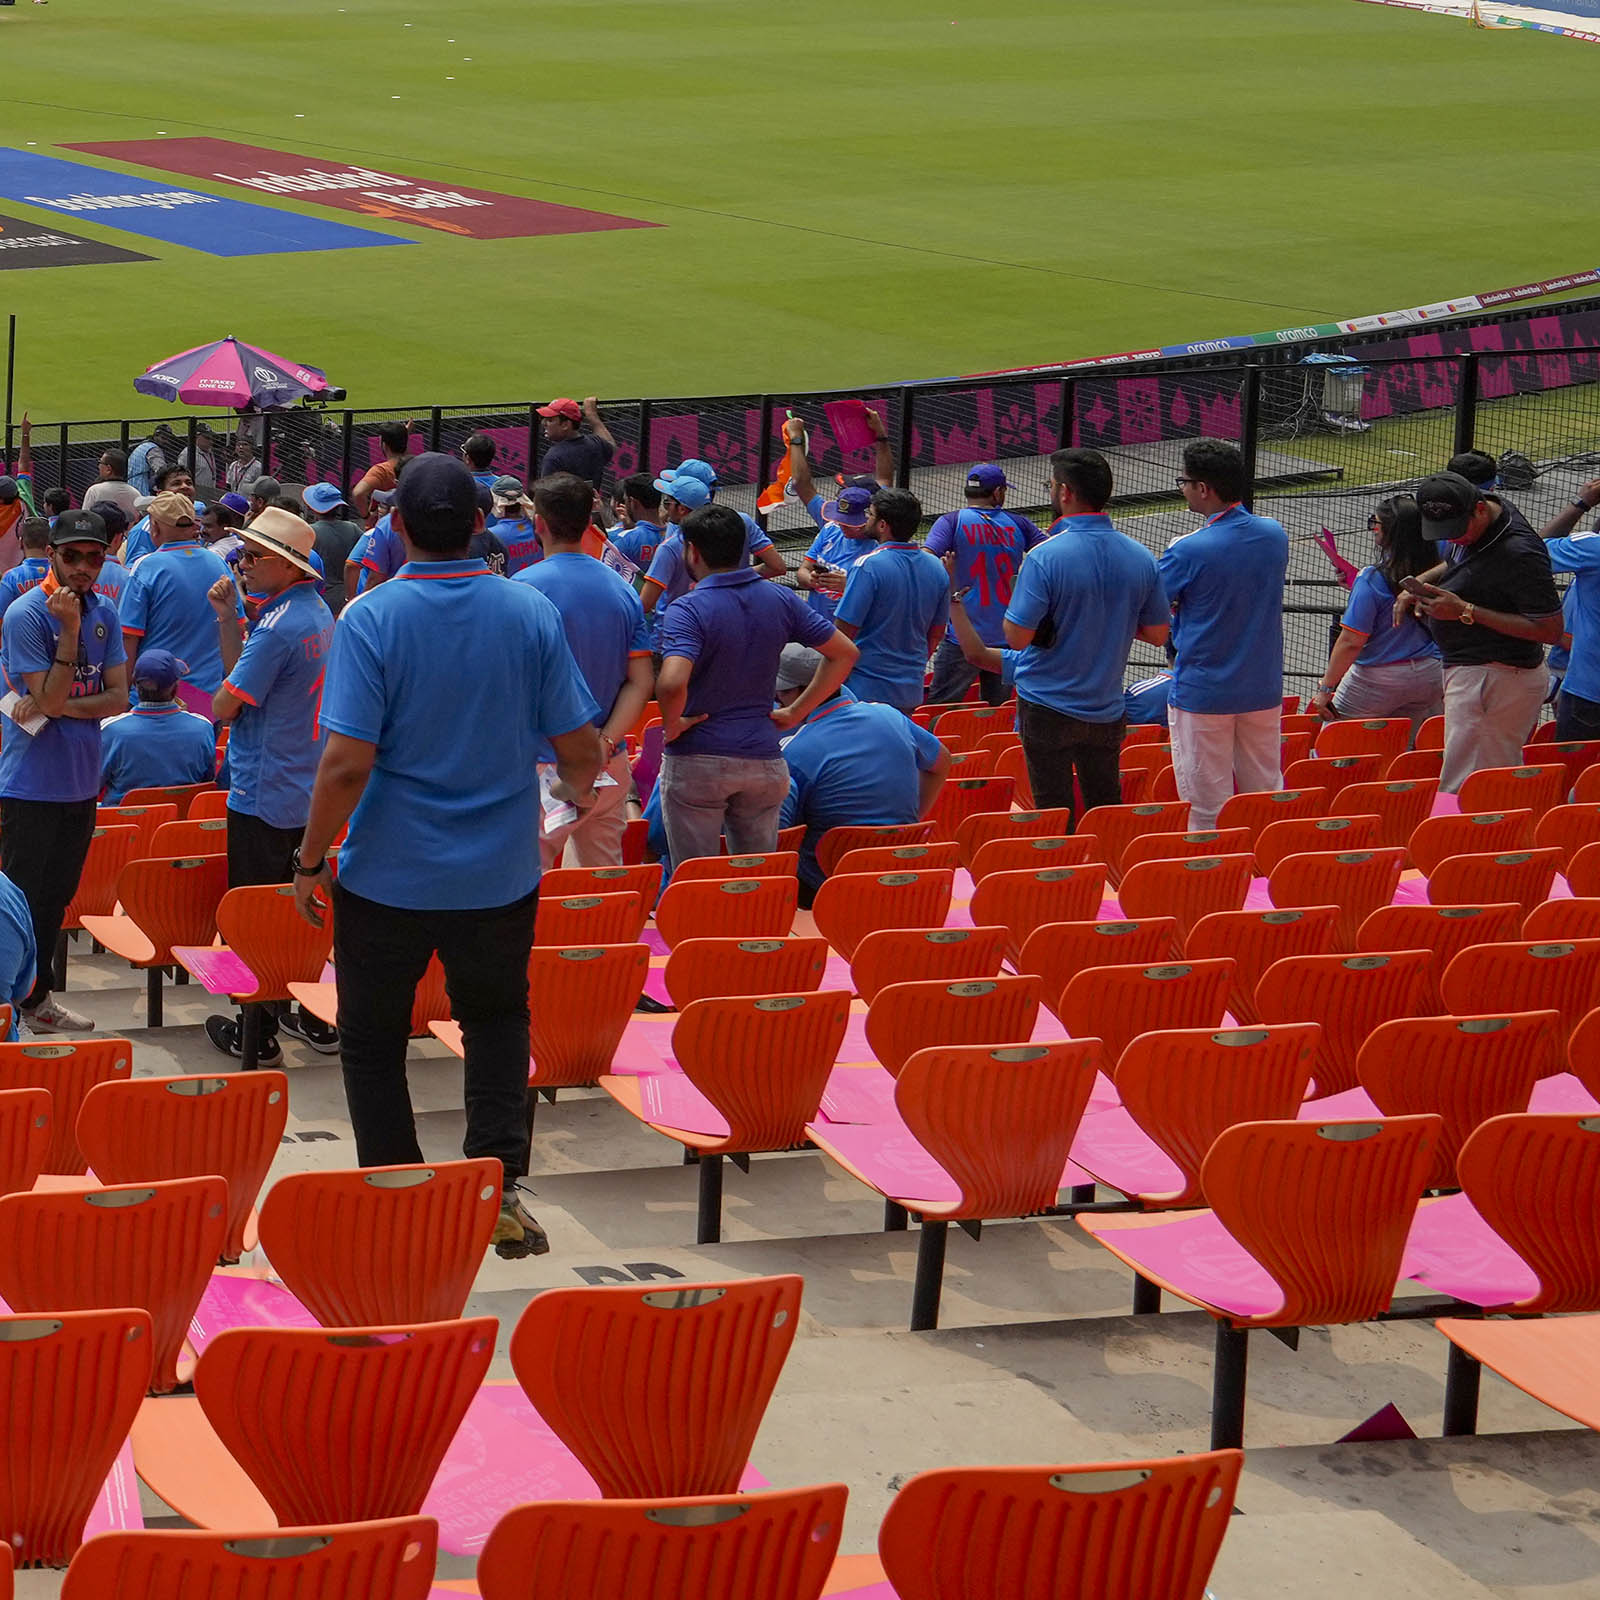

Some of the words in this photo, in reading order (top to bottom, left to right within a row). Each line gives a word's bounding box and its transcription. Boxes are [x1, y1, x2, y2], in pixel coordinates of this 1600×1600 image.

[212, 165, 414, 195] IndusInd
[25, 187, 220, 212] Booking.com
[360, 186, 494, 211] Bank
[1275, 326, 1319, 343] aramco
[962, 524, 1016, 547] VIRAT
[969, 551, 1015, 607] 18
